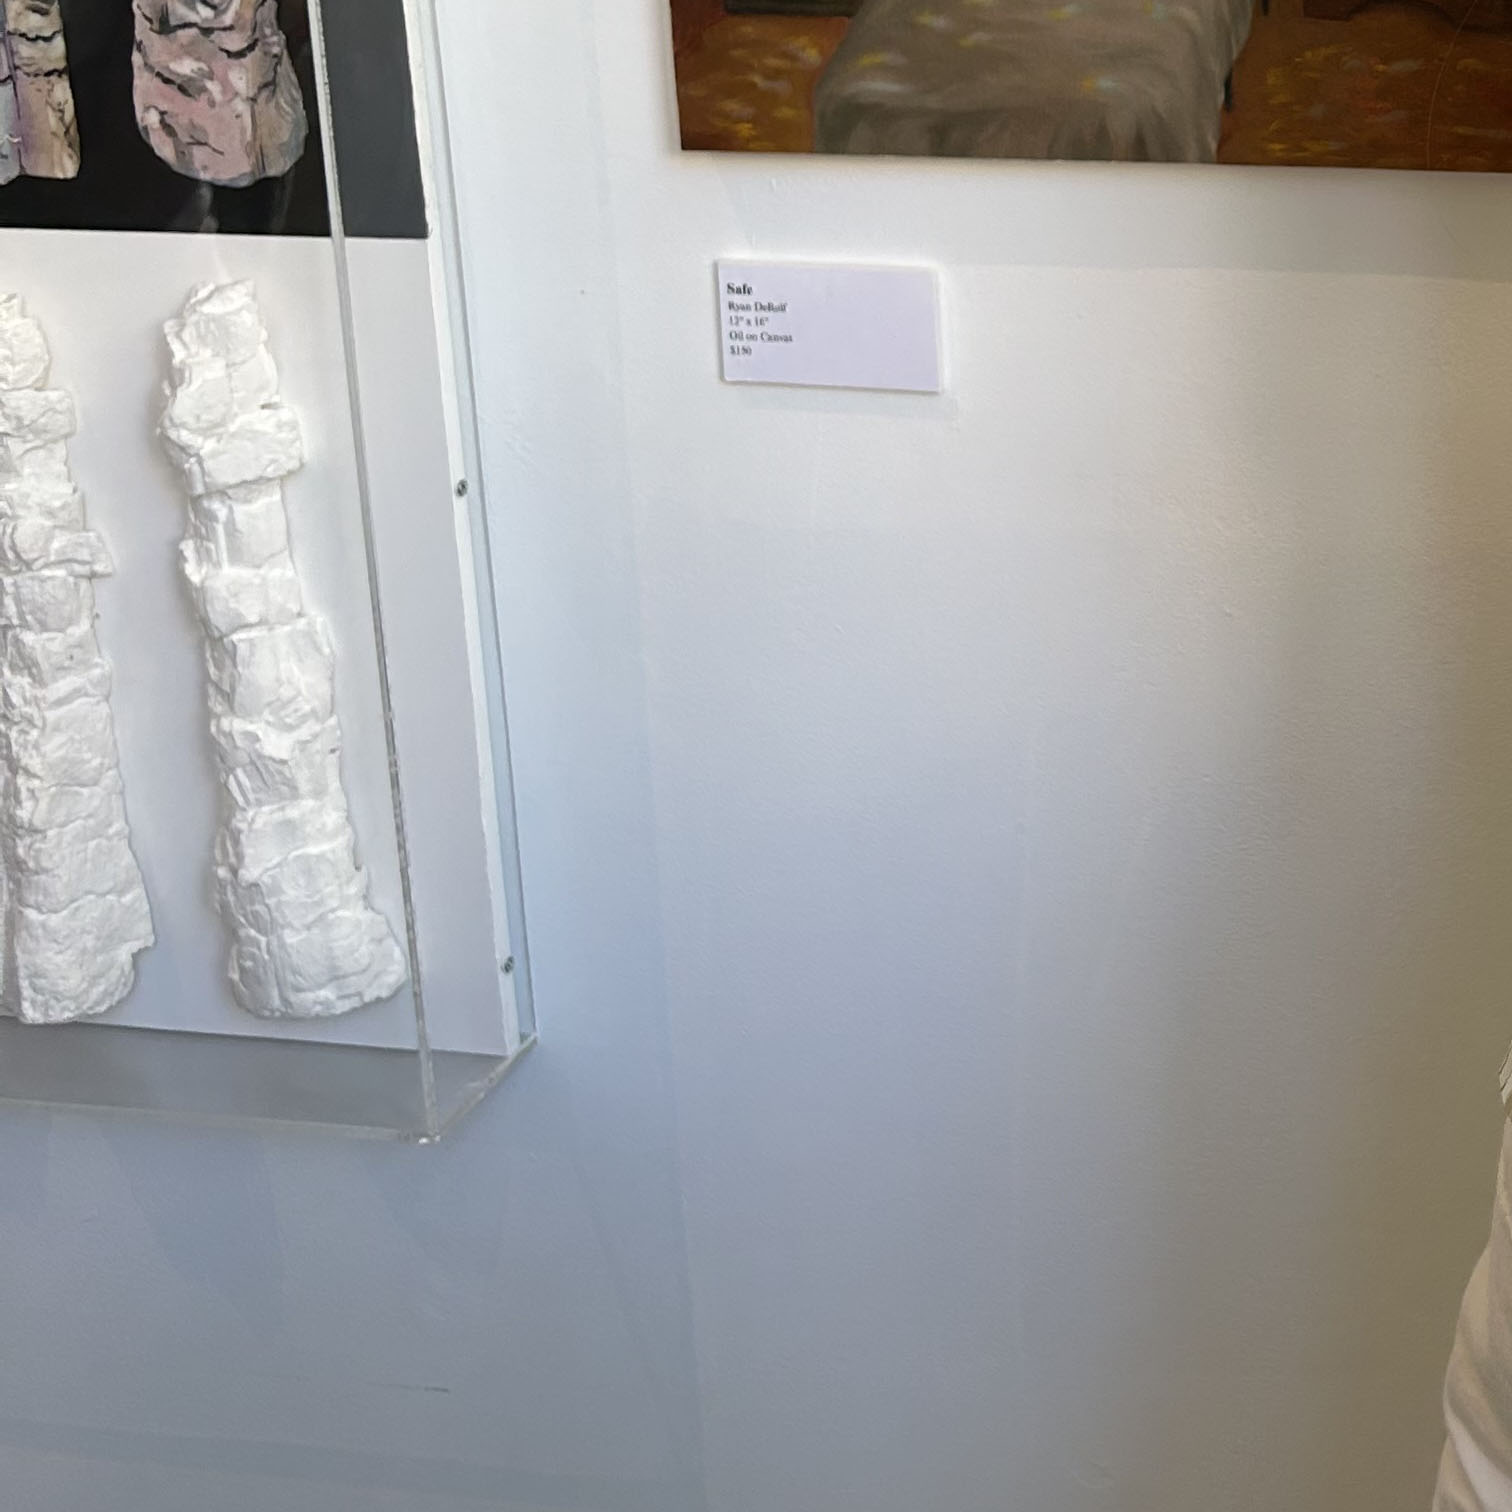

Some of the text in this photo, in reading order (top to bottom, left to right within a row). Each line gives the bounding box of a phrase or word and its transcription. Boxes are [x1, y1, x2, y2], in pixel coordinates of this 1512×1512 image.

[727, 282, 753, 295] Safe
[729, 330, 793, 343] Oil on Canvas
